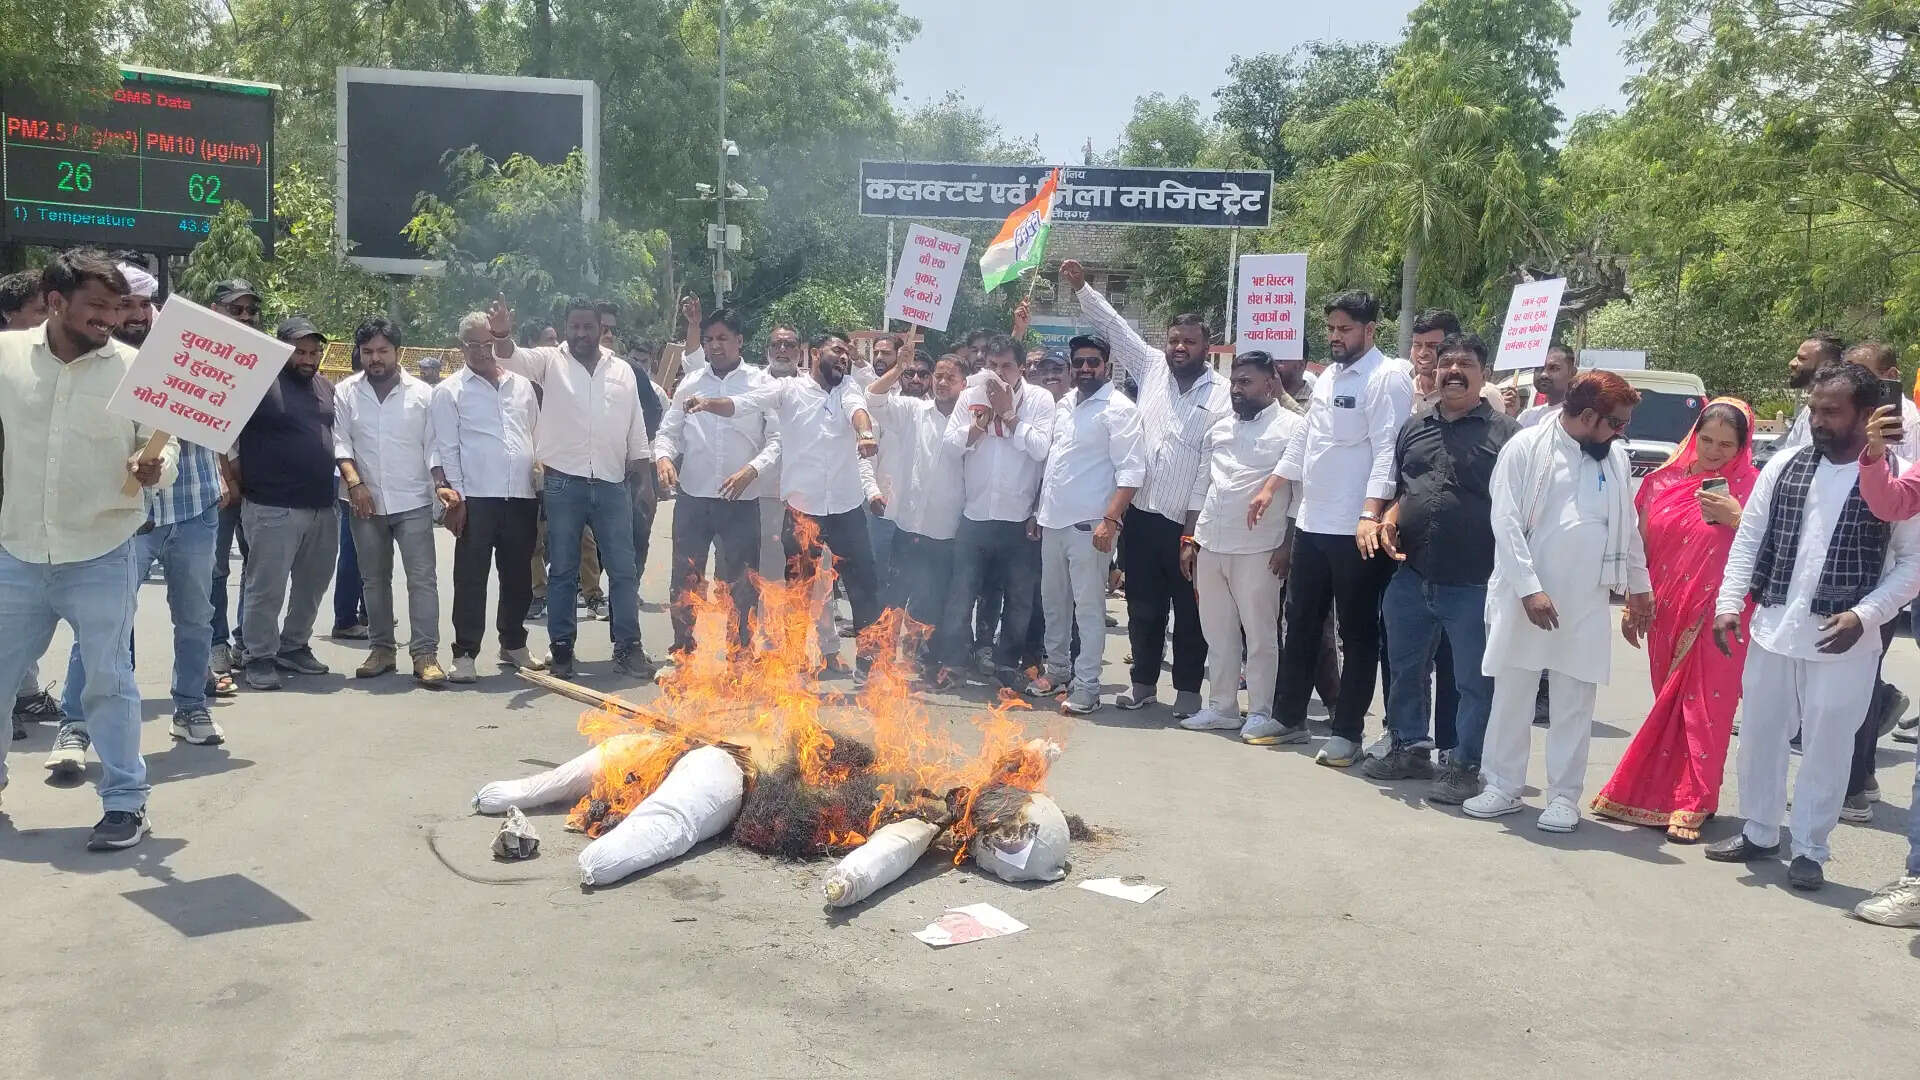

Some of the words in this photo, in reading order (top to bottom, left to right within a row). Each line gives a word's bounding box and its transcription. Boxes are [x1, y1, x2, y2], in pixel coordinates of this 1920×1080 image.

[104, 88, 152, 105] QMS
[155, 94, 192, 110] Data
[7, 117, 67, 142] PM2.5
[147, 132, 195, 155] PM10
[57, 161, 92, 192] 26
[188, 173, 222, 204] 62
[989, 175, 1031, 205] एवं
[13, 206, 28, 222] 1)
[37, 207, 136, 229] Temperature
[1266, 274, 1294, 286] सिस्टम
[1279, 309, 1291, 322] को
[180, 329, 236, 360] युवाओं
[233, 351, 259, 370] की
[173, 351, 190, 368] ये
[189, 360, 237, 390] हुंकार,
[162, 373, 208, 400] जवाब
[208, 391, 227, 407] दो
[132, 385, 169, 409] मोदी
[169, 399, 232, 432] सरकार!
